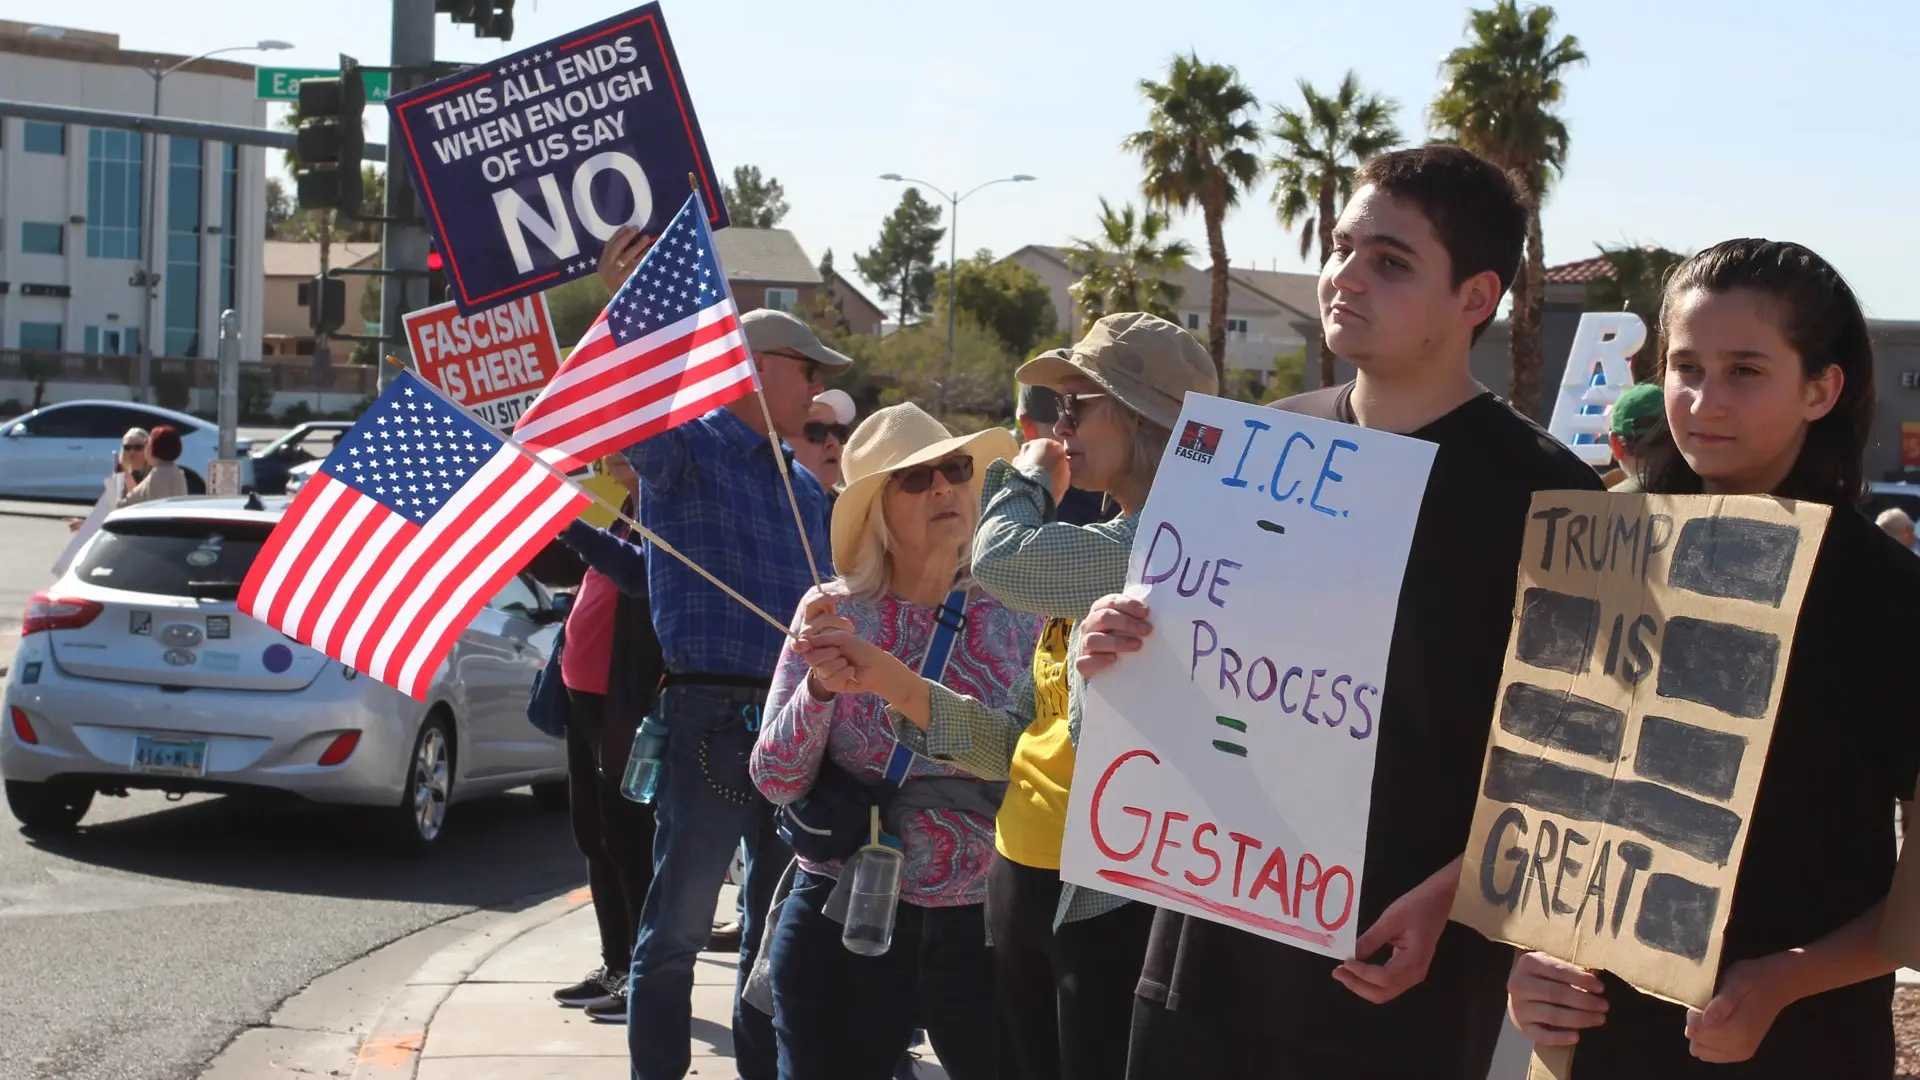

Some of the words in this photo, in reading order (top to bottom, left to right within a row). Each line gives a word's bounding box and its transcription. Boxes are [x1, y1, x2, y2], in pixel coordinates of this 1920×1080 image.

[425, 87, 498, 130] THIS
[502, 69, 556, 107] ALL
[556, 36, 638, 86] ENDS
[432, 113, 524, 165] WHEN
[525, 65, 654, 132] ENOUGH
[481, 149, 521, 183] OF
[524, 133, 569, 167] US
[571, 109, 626, 151] SAY
[491, 151, 653, 275] NO
[418, 296, 540, 363] FASCISM
[436, 363, 467, 401] IS
[466, 342, 544, 396] HERE
[497, 399, 521, 424] SIT
[1175, 446, 1213, 464] FASCIST
[1220, 419, 1359, 518] I.C.E.
[1141, 521, 1243, 608] DUE
[1532, 507, 1674, 582] TRUMP
[1191, 619, 1378, 740] PROCESS
[1603, 613, 1658, 684] IS
[1090, 749, 1354, 931] GESTAPO
[1479, 806, 1656, 939] GREAT
